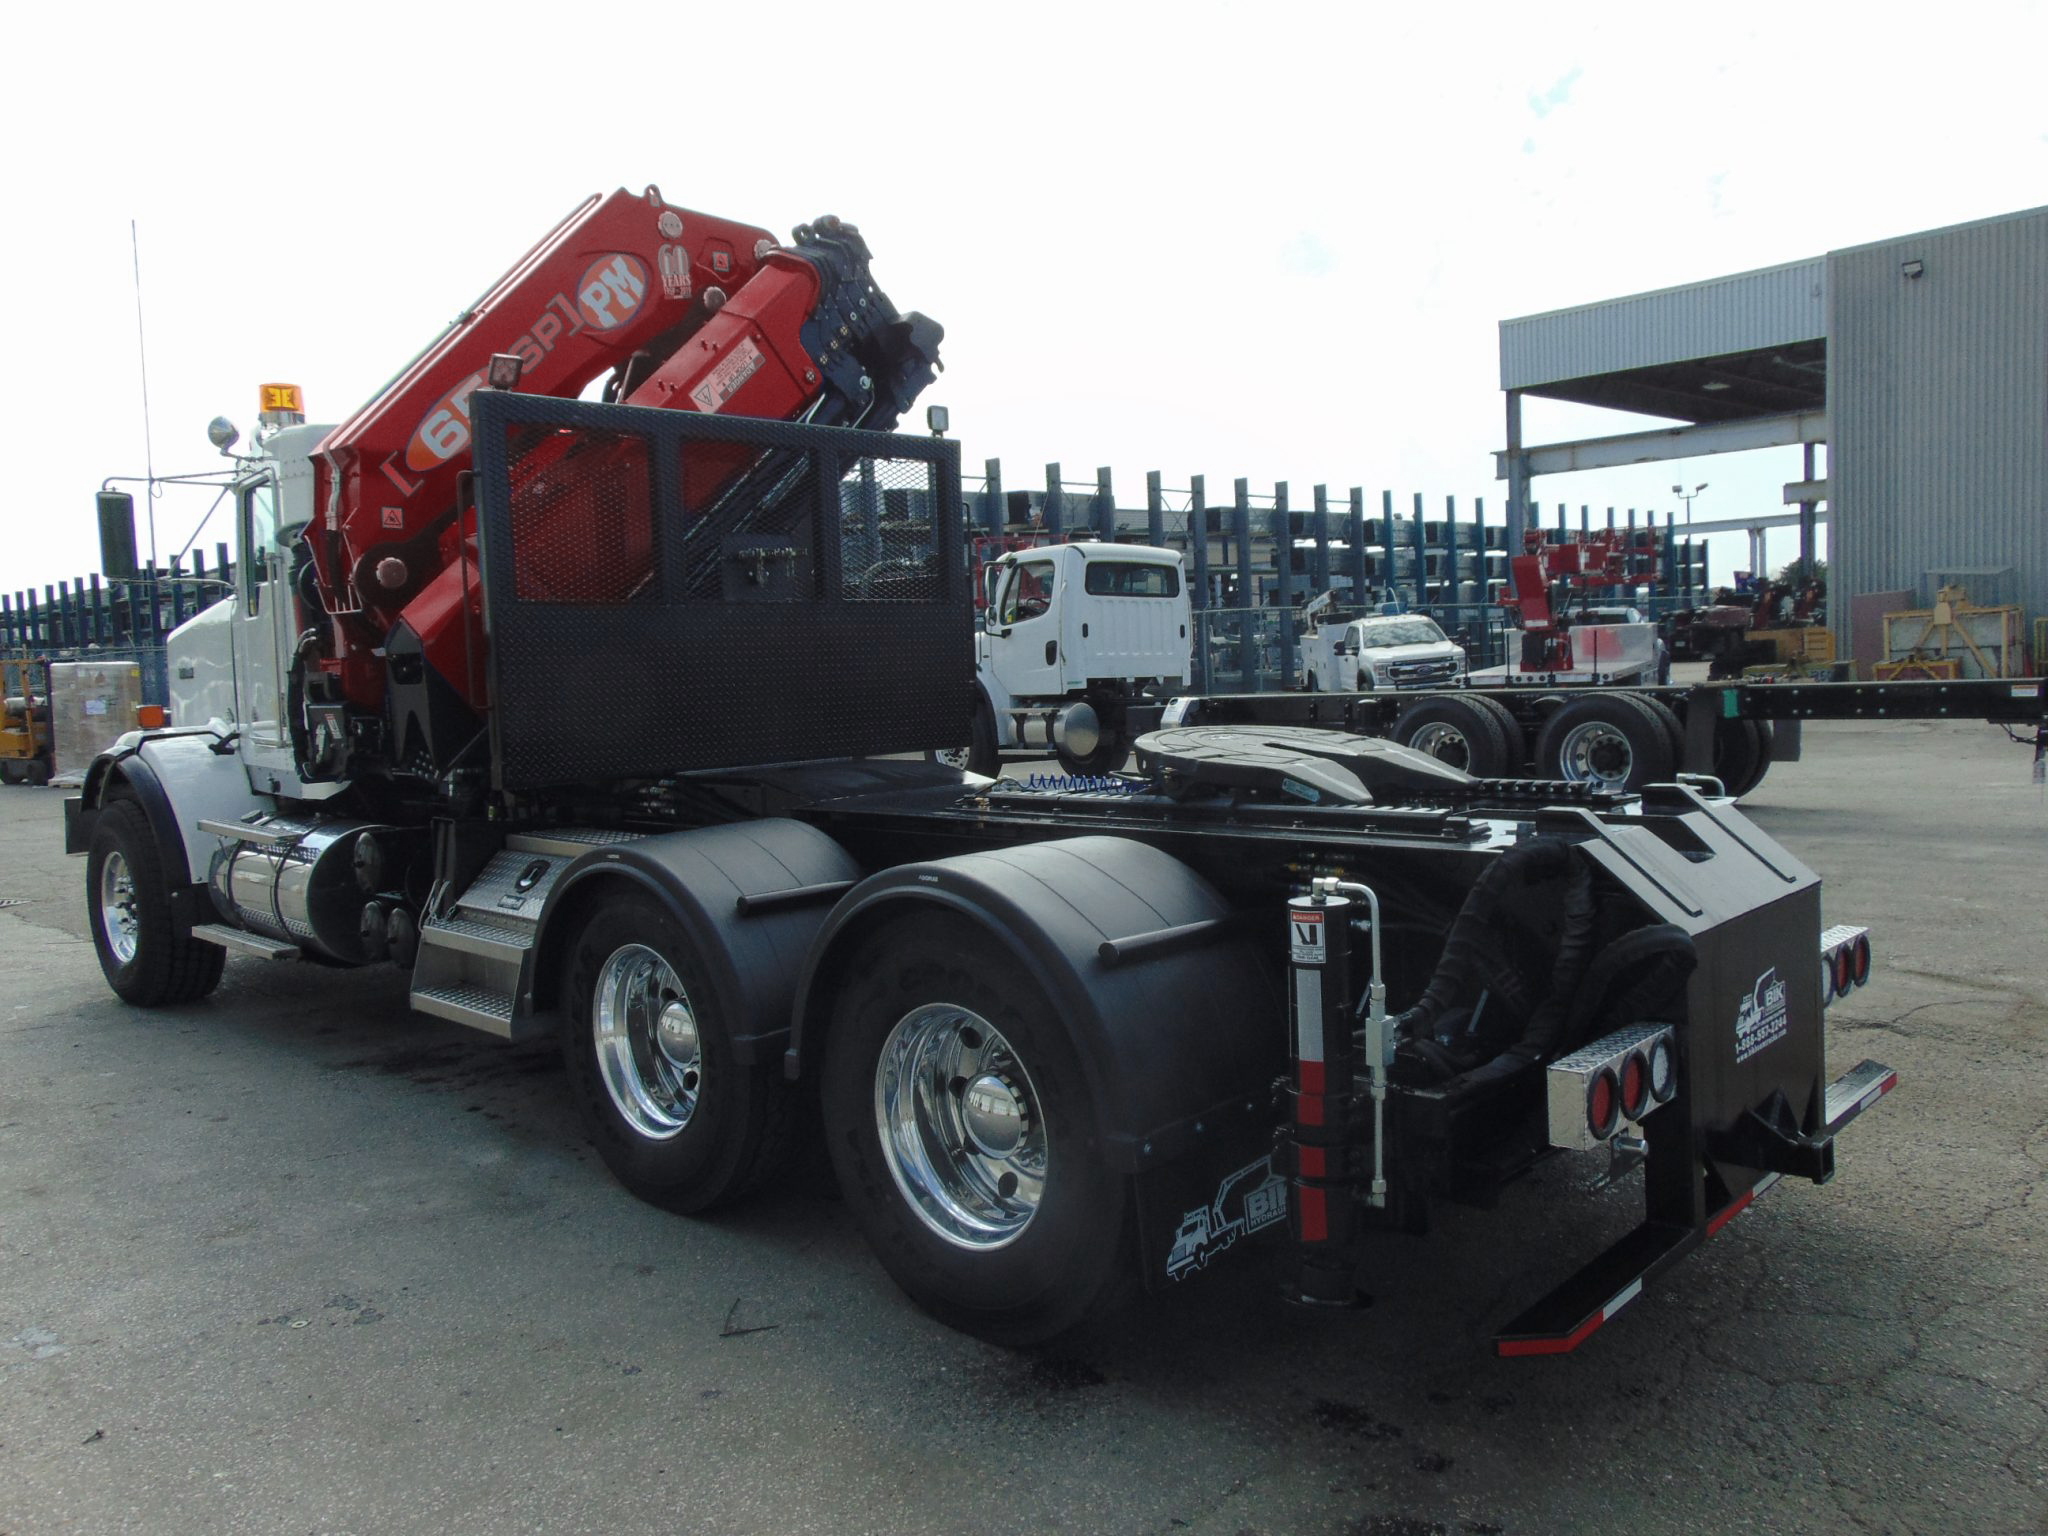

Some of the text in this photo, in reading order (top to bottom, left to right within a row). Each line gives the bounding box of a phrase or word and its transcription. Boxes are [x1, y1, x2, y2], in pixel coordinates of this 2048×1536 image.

[658, 243, 689, 276] 60
[580, 255, 645, 328] PM
[661, 273, 691, 287] YEARS
[727, 366, 753, 393] DANGER
[1765, 983, 1785, 1007] BIK
